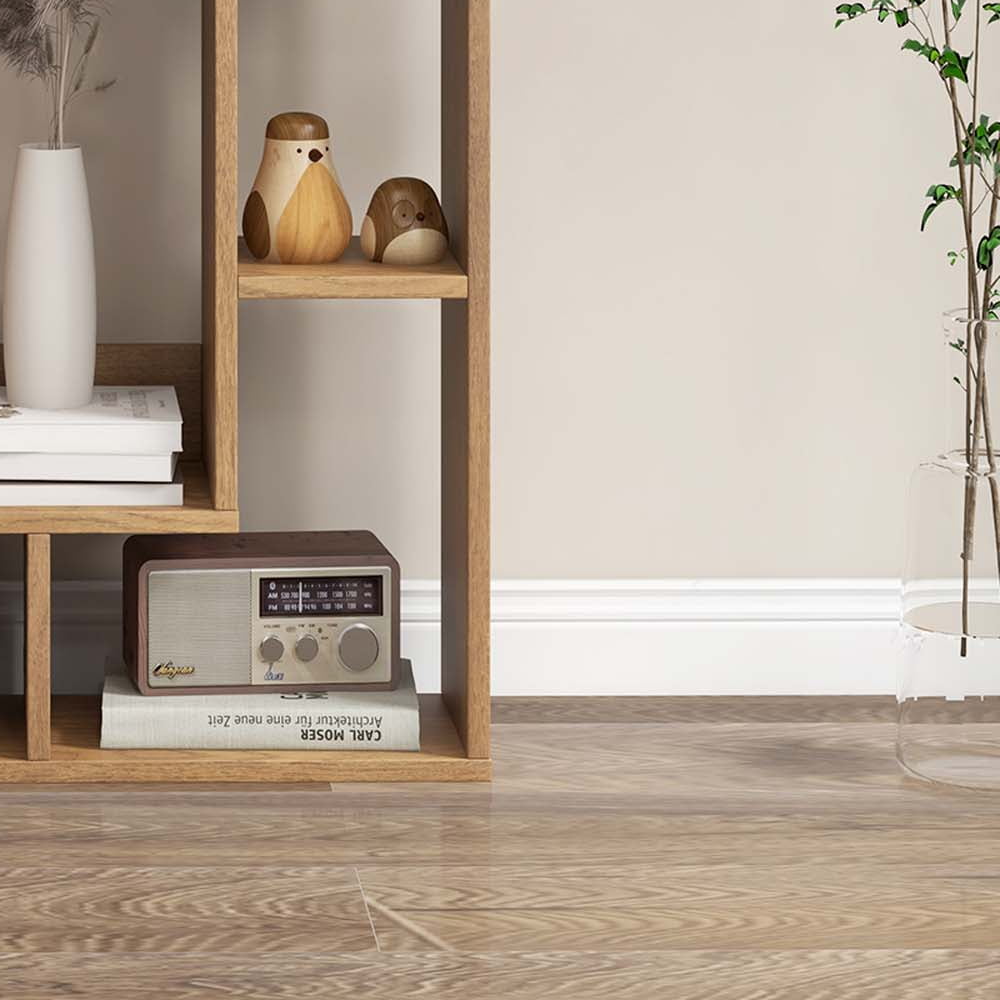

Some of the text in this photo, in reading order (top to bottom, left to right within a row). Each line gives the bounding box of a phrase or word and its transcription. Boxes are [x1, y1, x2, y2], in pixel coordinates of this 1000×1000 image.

[207, 714, 383, 728] Architektur für eine neue Zeit
[300, 729, 382, 741] CARL MOSER
